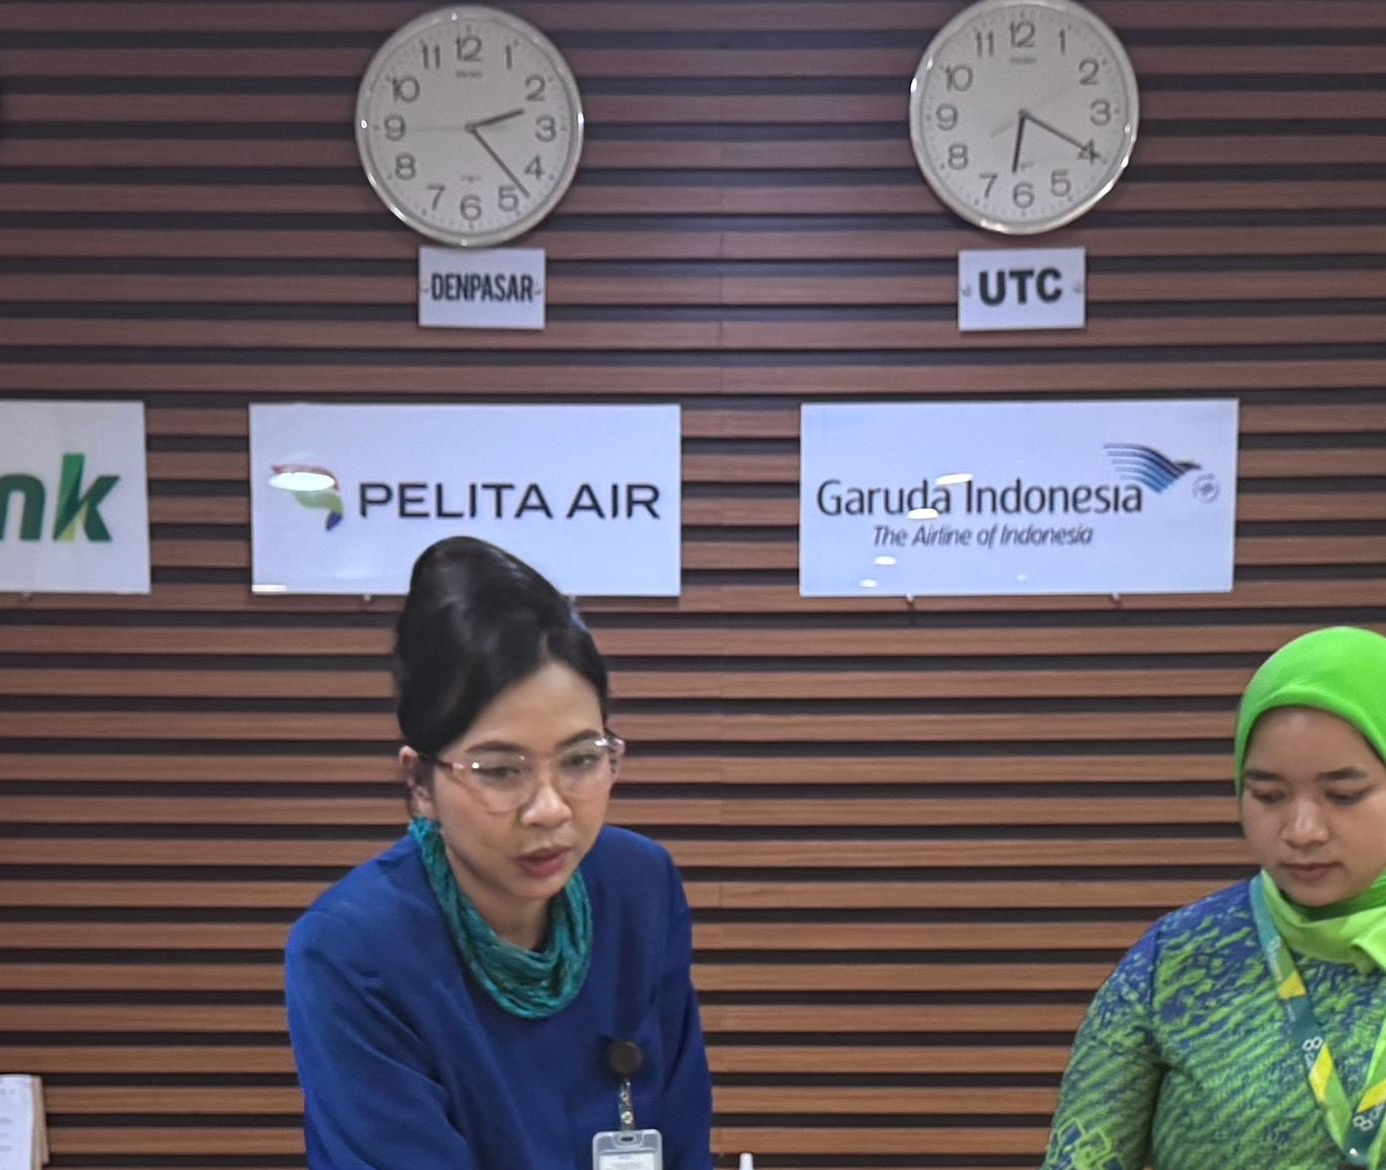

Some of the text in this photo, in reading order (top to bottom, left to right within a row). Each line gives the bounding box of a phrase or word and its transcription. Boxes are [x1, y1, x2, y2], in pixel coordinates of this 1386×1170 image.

[975, 31, 994, 57] 11
[1010, 21, 1036, 48] 12
[421, 43, 441, 69] 11
[456, 37, 482, 62] 12
[945, 65, 973, 92] 10
[1078, 58, 1099, 85] 2
[393, 76, 420, 102] 10
[525, 75, 545, 101] 2
[936, 103, 957, 131] 9
[1090, 99, 1111, 125] 3
[383, 114, 406, 141] 9
[535, 115, 556, 142] 3
[395, 153, 416, 180] 8
[525, 155, 545, 178] 4
[948, 143, 969, 169] 8
[980, 173, 998, 198] 7
[1013, 182, 1034, 208] 6
[1050, 170, 1071, 197] 5
[427, 185, 446, 210] 7
[460, 195, 482, 220] 6
[431, 274, 533, 303] DENPASAR
[979, 268, 1061, 306] UTC
[359, 483, 660, 519] PELITA AIR
[816, 477, 1144, 517] Garuda Indonesia
[873, 524, 1094, 549] The Airline of Indonesia
